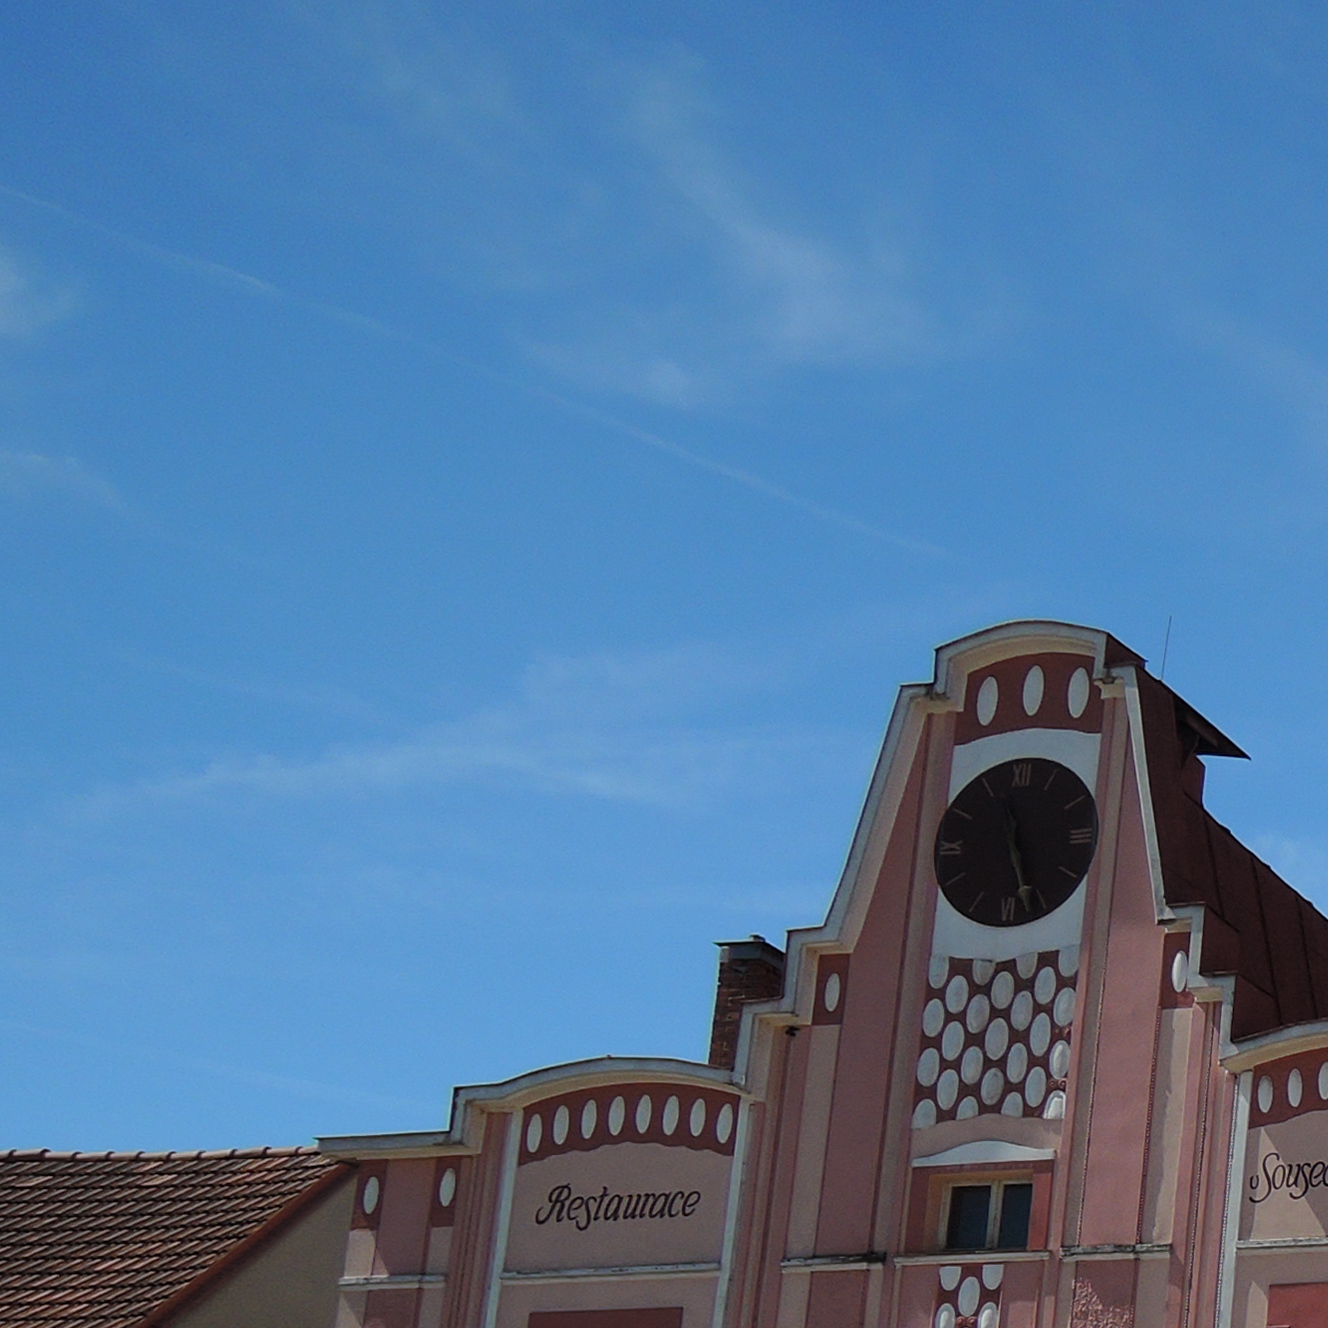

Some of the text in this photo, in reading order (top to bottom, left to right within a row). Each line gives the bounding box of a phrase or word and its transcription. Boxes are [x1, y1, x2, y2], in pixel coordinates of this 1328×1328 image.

[1011, 763, 1032, 788] XII
[1069, 827, 1093, 844] III
[535, 1182, 701, 1232] Restaurace
